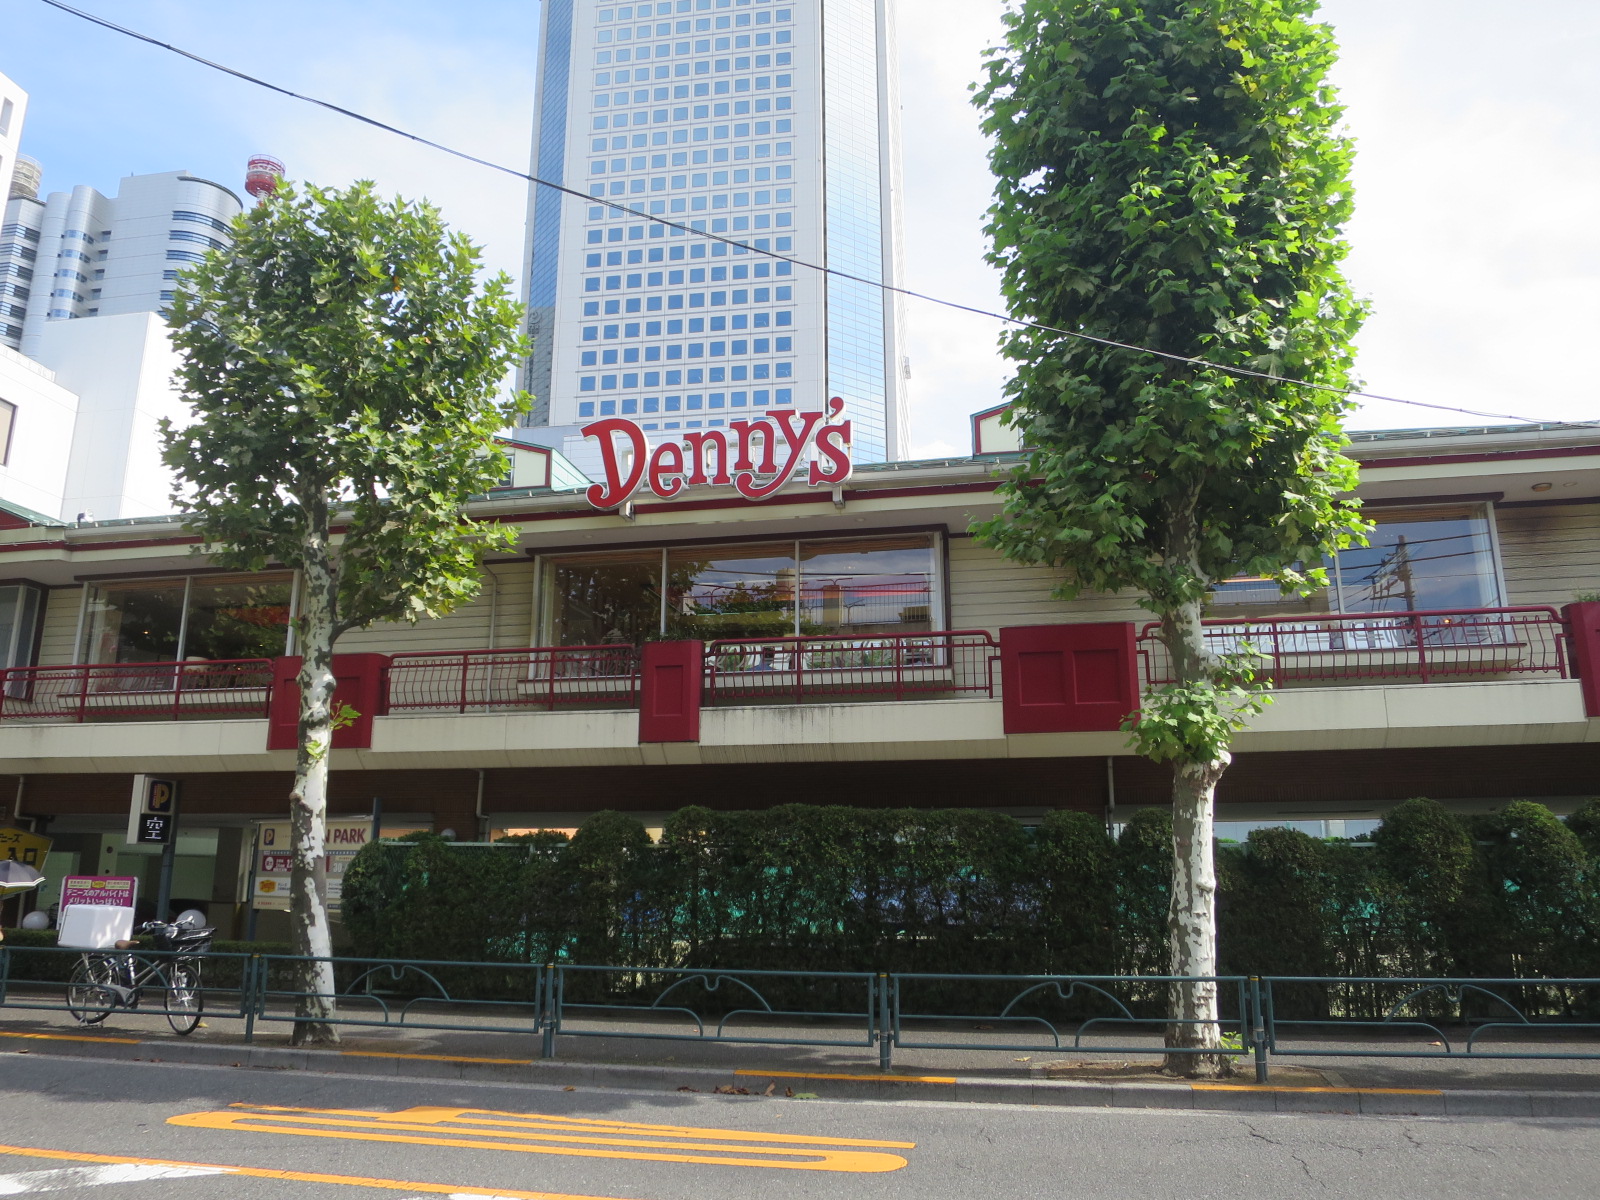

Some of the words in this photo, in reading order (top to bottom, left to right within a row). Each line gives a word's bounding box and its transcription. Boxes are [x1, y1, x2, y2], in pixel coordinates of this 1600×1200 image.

[579, 396, 852, 510] Denny's
[145, 816, 163, 840] 空
[334, 828, 366, 844] PARK
[7, 847, 38, 866] 入口
[66, 889, 130, 897] デニーズのアルバイトは
